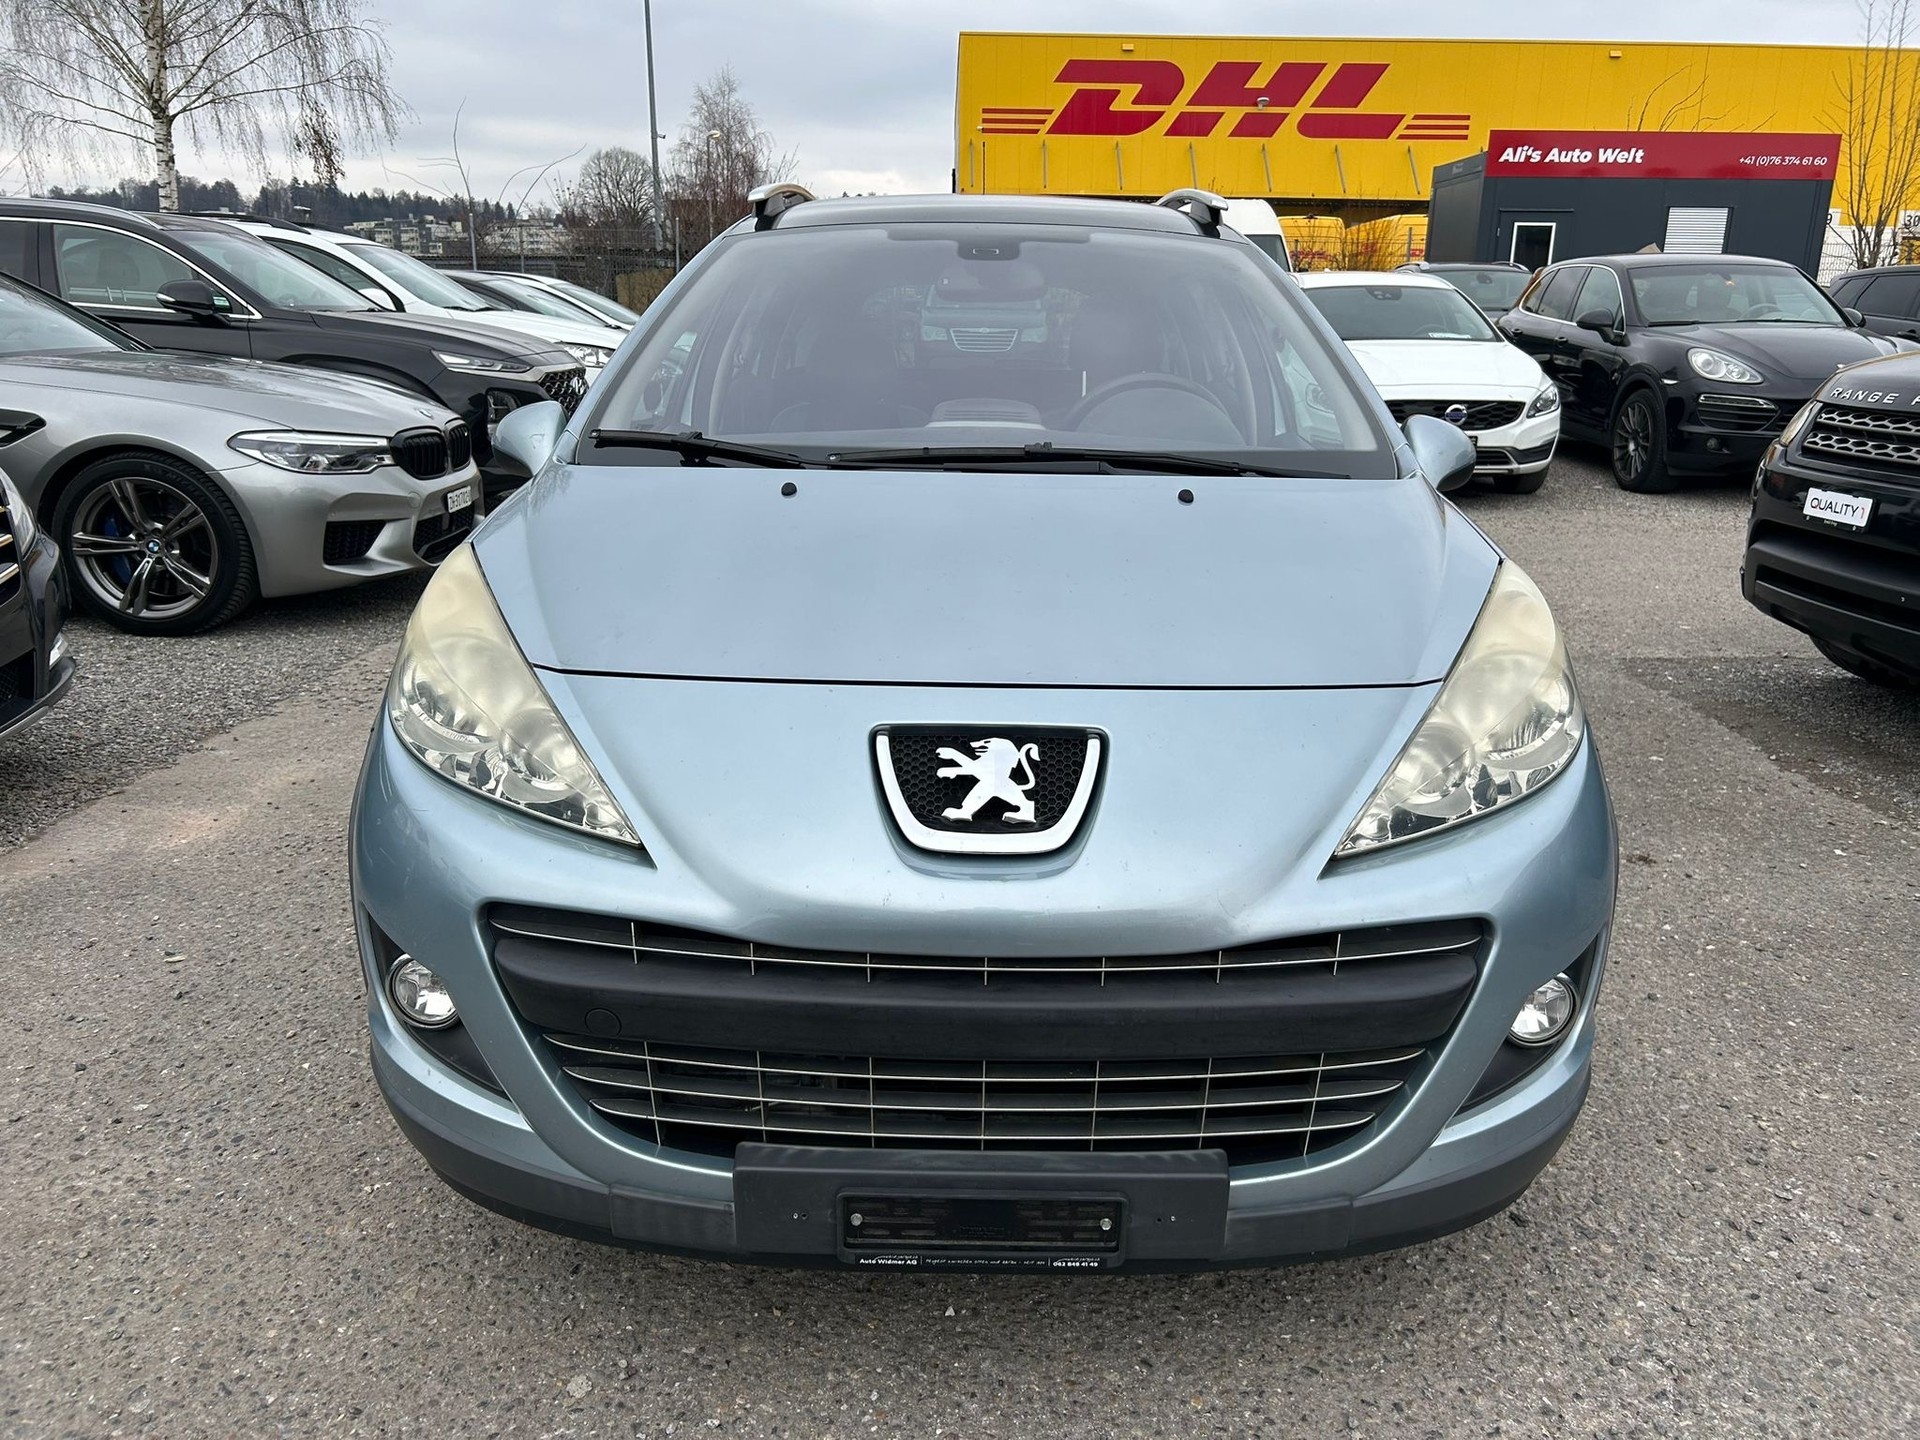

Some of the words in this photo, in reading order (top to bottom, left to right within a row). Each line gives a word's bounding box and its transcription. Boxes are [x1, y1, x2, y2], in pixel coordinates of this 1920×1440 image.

[1045, 59, 1407, 139] DHL
[1544, 147, 1593, 163] Auto
[1598, 147, 1645, 164] Welt
[1739, 156, 1756, 165] +41
[1755, 155, 1782, 167] (0)76
[1782, 156, 1801, 165] 374
[1802, 156, 1813, 166] 61
[1814, 156, 1828, 166] 60
[1830, 387, 1900, 404] RANGE
[1810, 497, 1860, 517] QUALITY
[1860, 507, 1865, 519] 1
